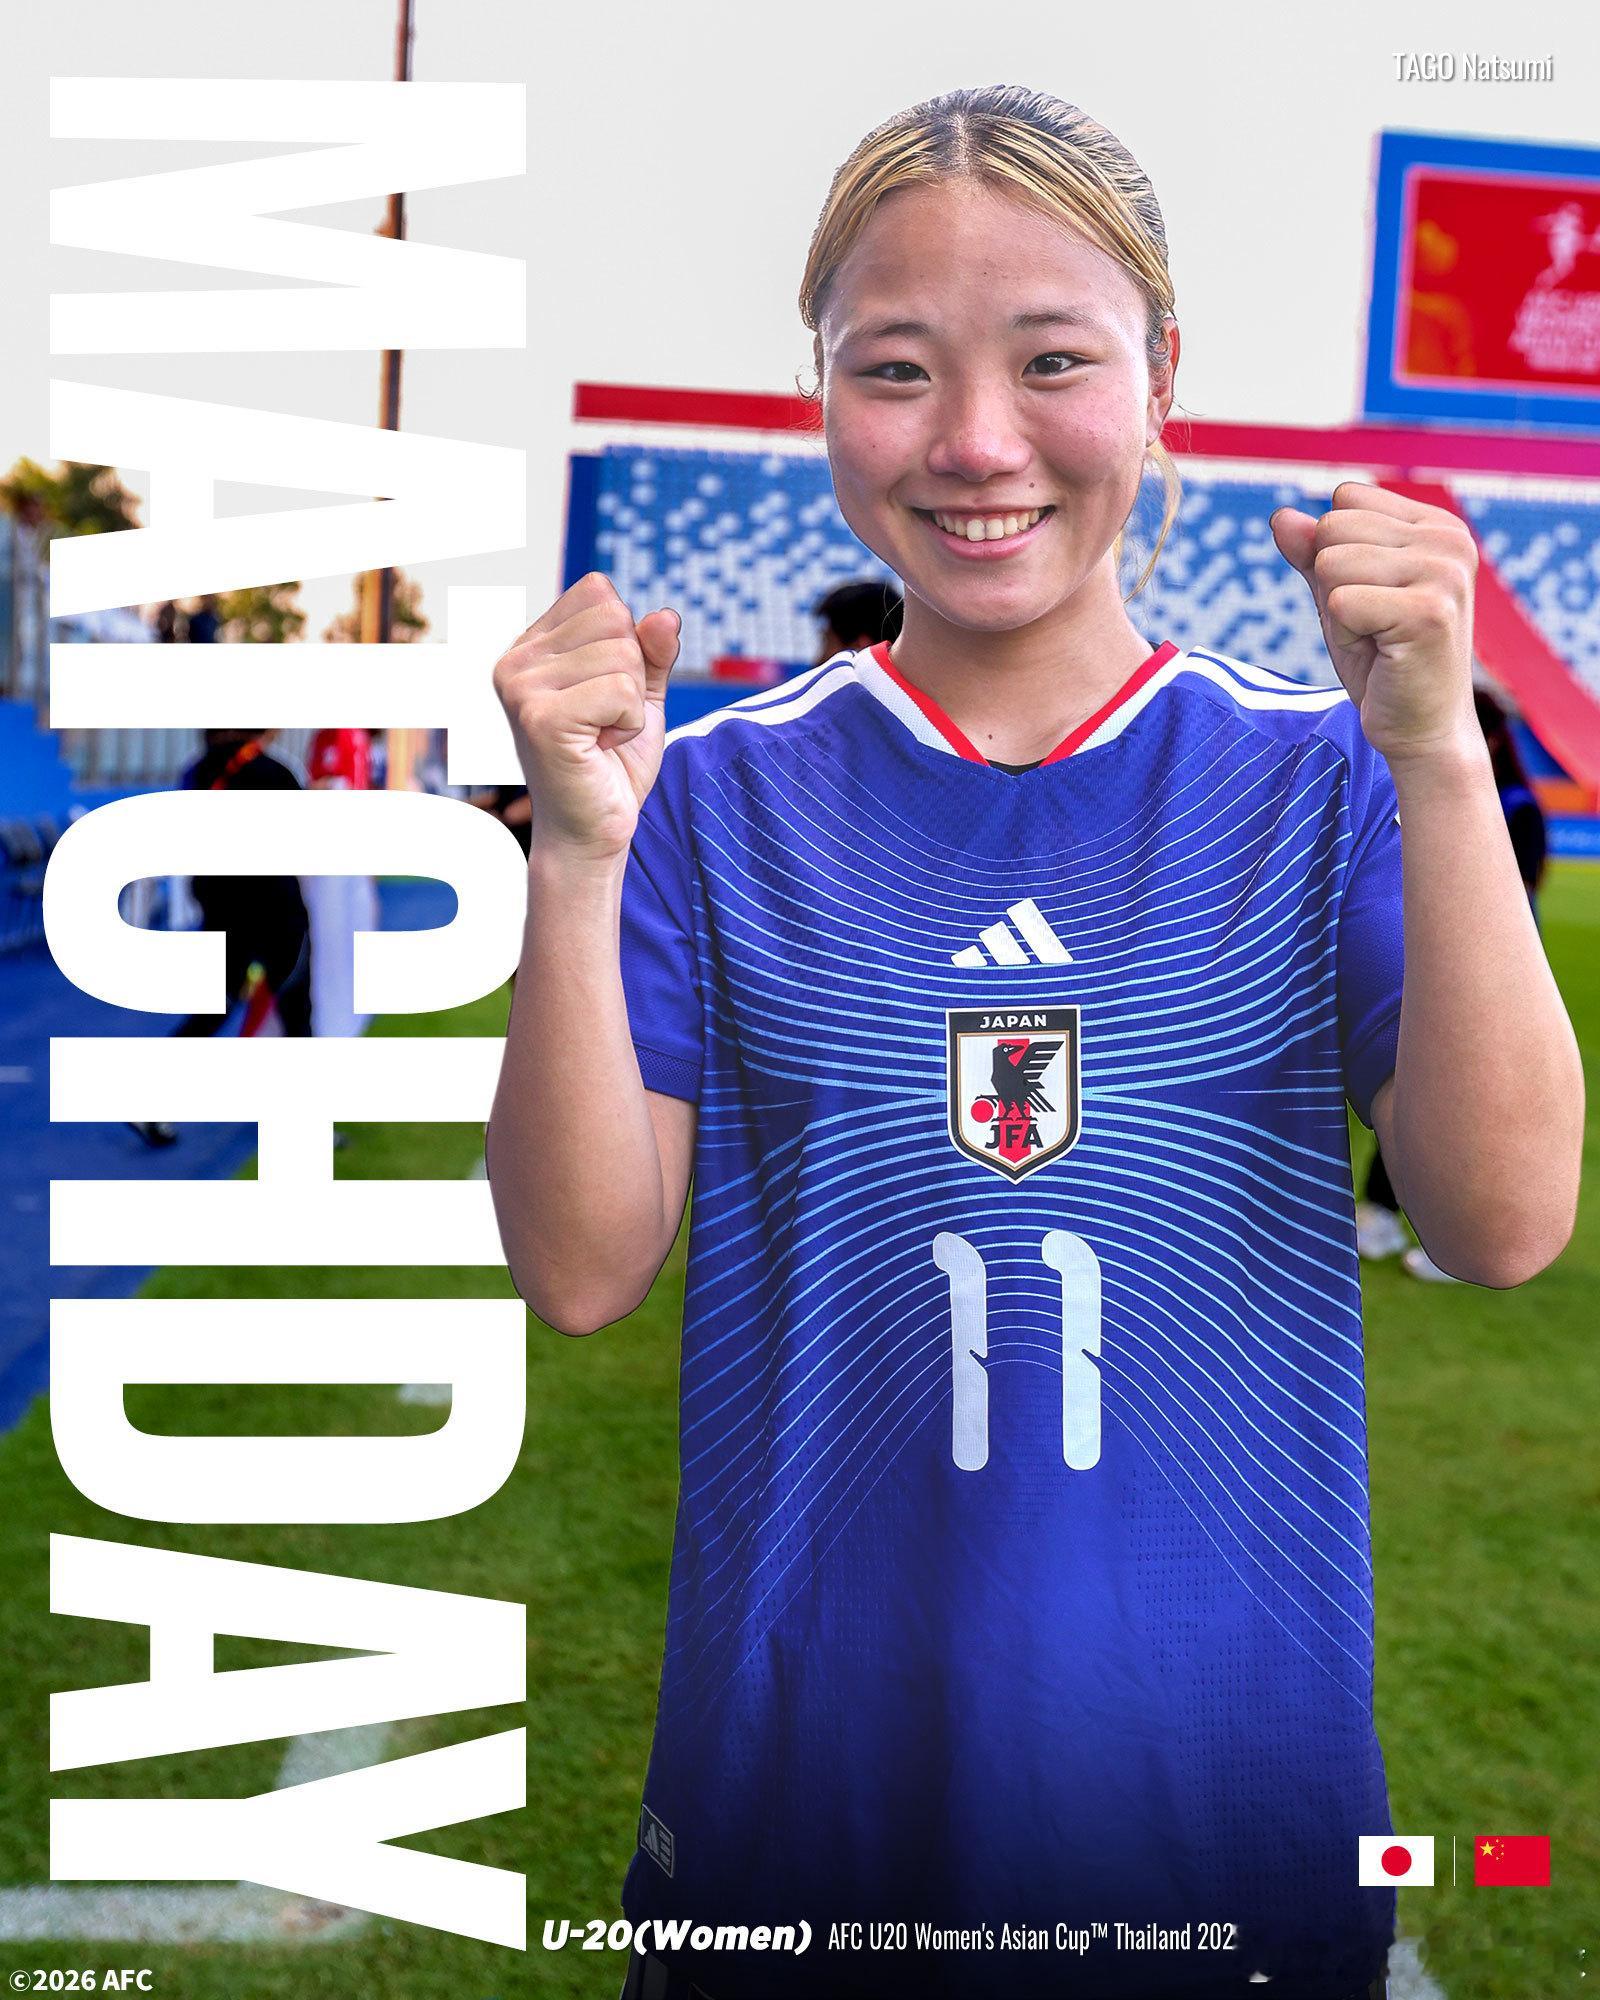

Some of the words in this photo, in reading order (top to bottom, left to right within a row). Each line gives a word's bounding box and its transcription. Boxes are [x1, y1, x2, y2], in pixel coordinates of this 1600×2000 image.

[979, 1014, 1047, 1029] JAPAN
[985, 1123, 1043, 1149] JFA
[932, 1229, 1102, 1472] 11
